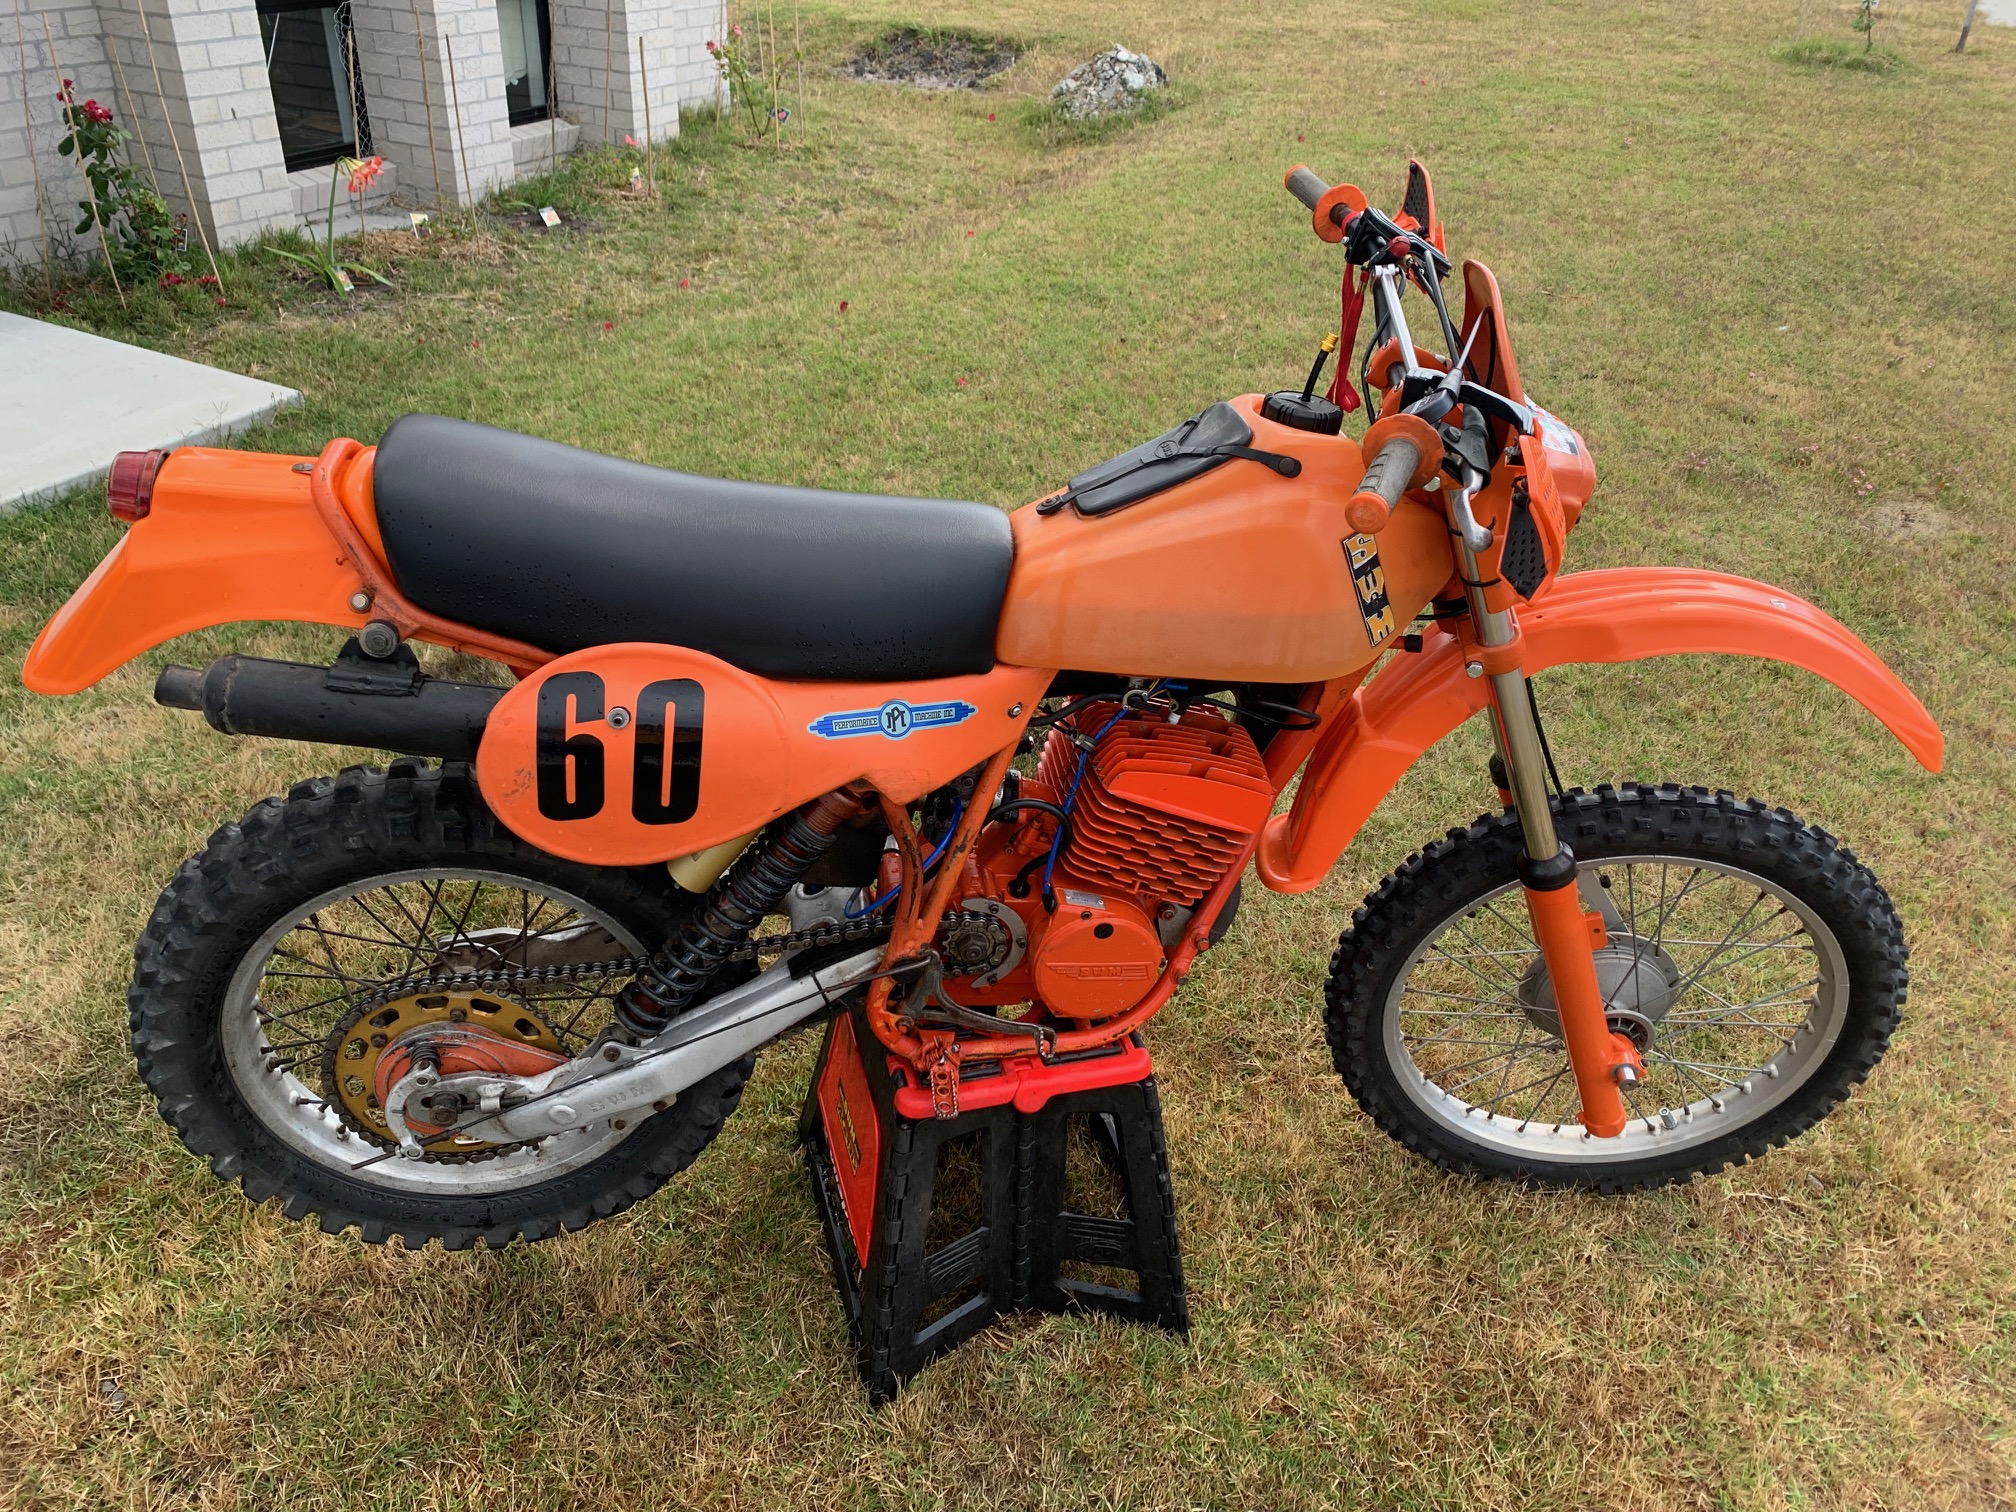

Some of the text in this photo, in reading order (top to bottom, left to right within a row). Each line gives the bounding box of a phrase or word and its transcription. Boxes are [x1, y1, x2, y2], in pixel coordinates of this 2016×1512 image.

[915, 710, 942, 721] MACHINE
[834, 717, 878, 730] PERFORMANCE
[537, 671, 705, 825] 60
[1080, 966, 1122, 977] SWM
[588, 1081, 652, 1113] SWM
